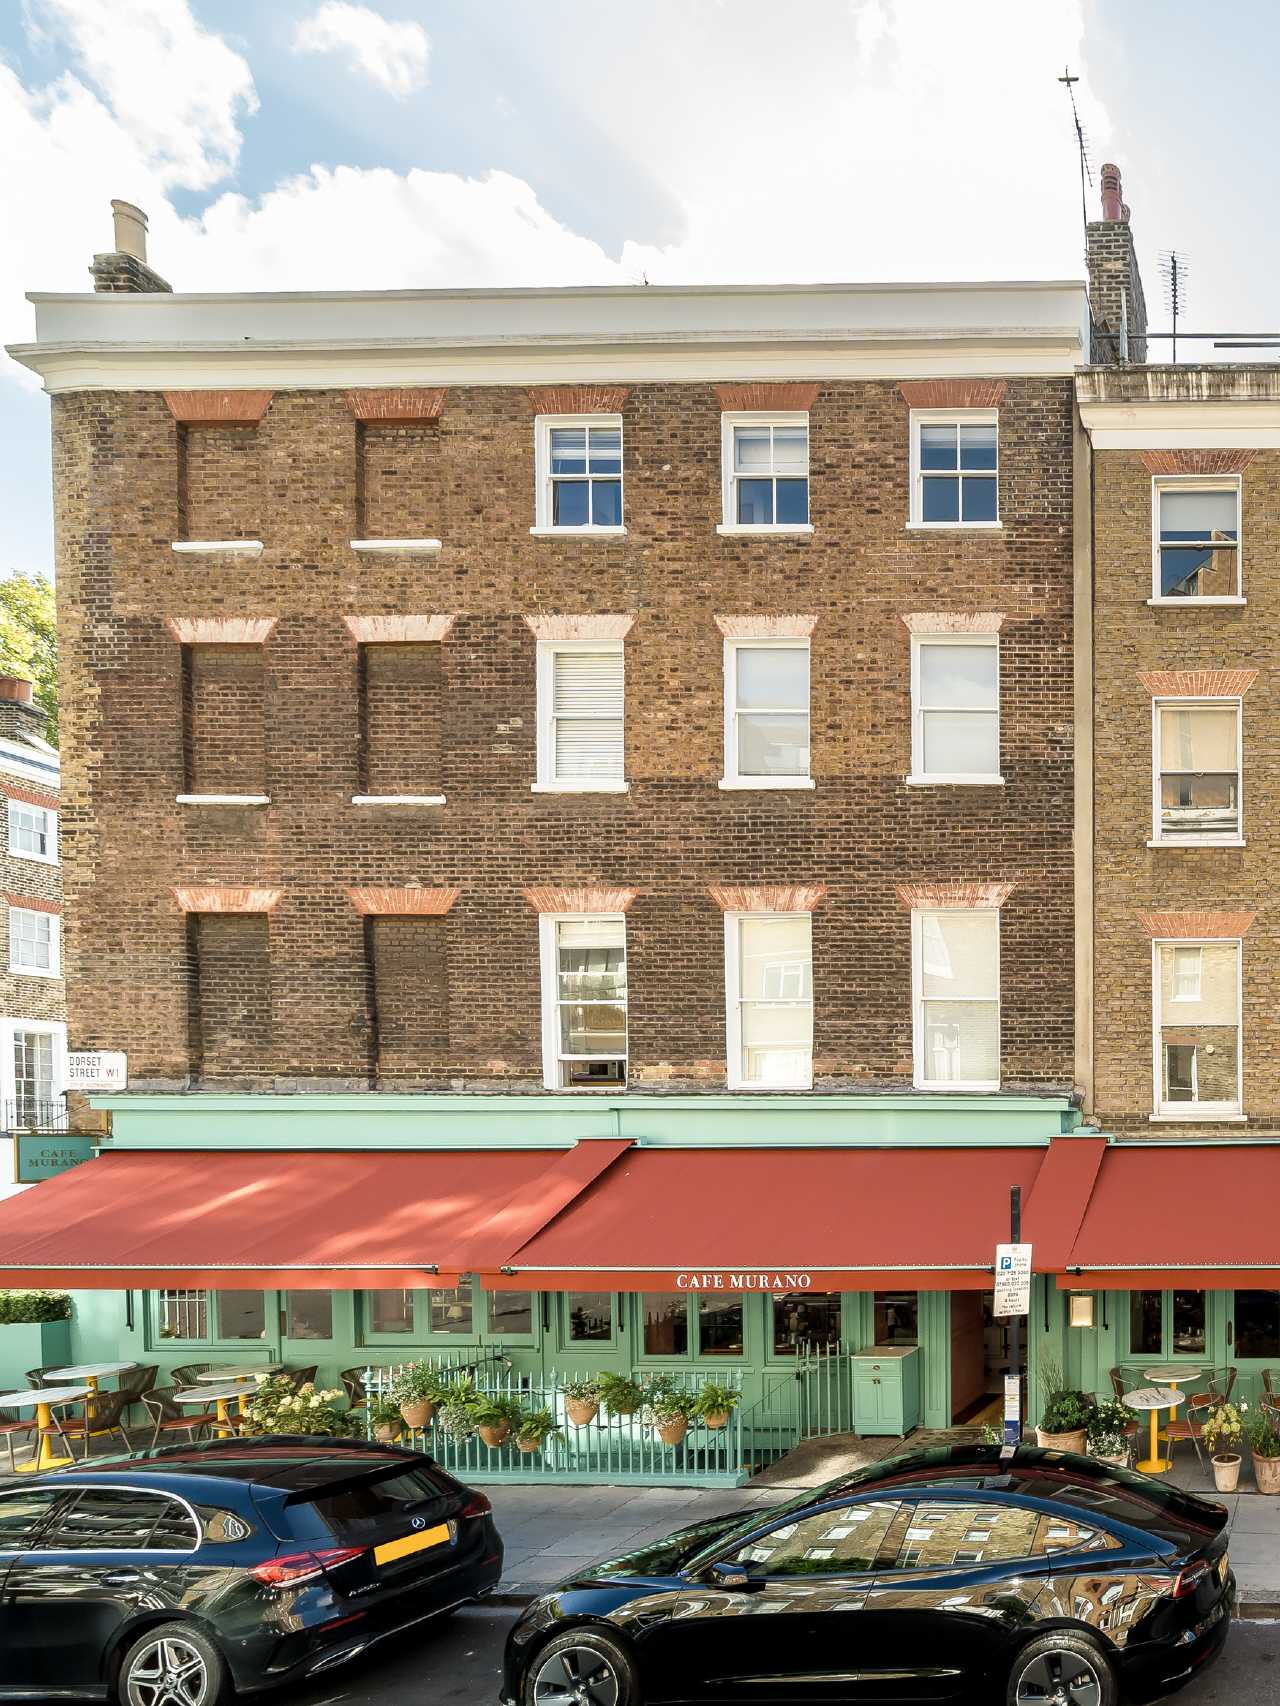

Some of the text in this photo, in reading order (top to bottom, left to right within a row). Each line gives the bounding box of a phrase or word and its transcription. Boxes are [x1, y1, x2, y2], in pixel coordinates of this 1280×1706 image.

[69, 1056, 101, 1066] DORSET
[69, 1068, 119, 1078] STREET W1
[40, 1150, 77, 1158] CAFE
[28, 1159, 88, 1168] MURAN
[676, 1274, 811, 1288] CAFE MURANO
